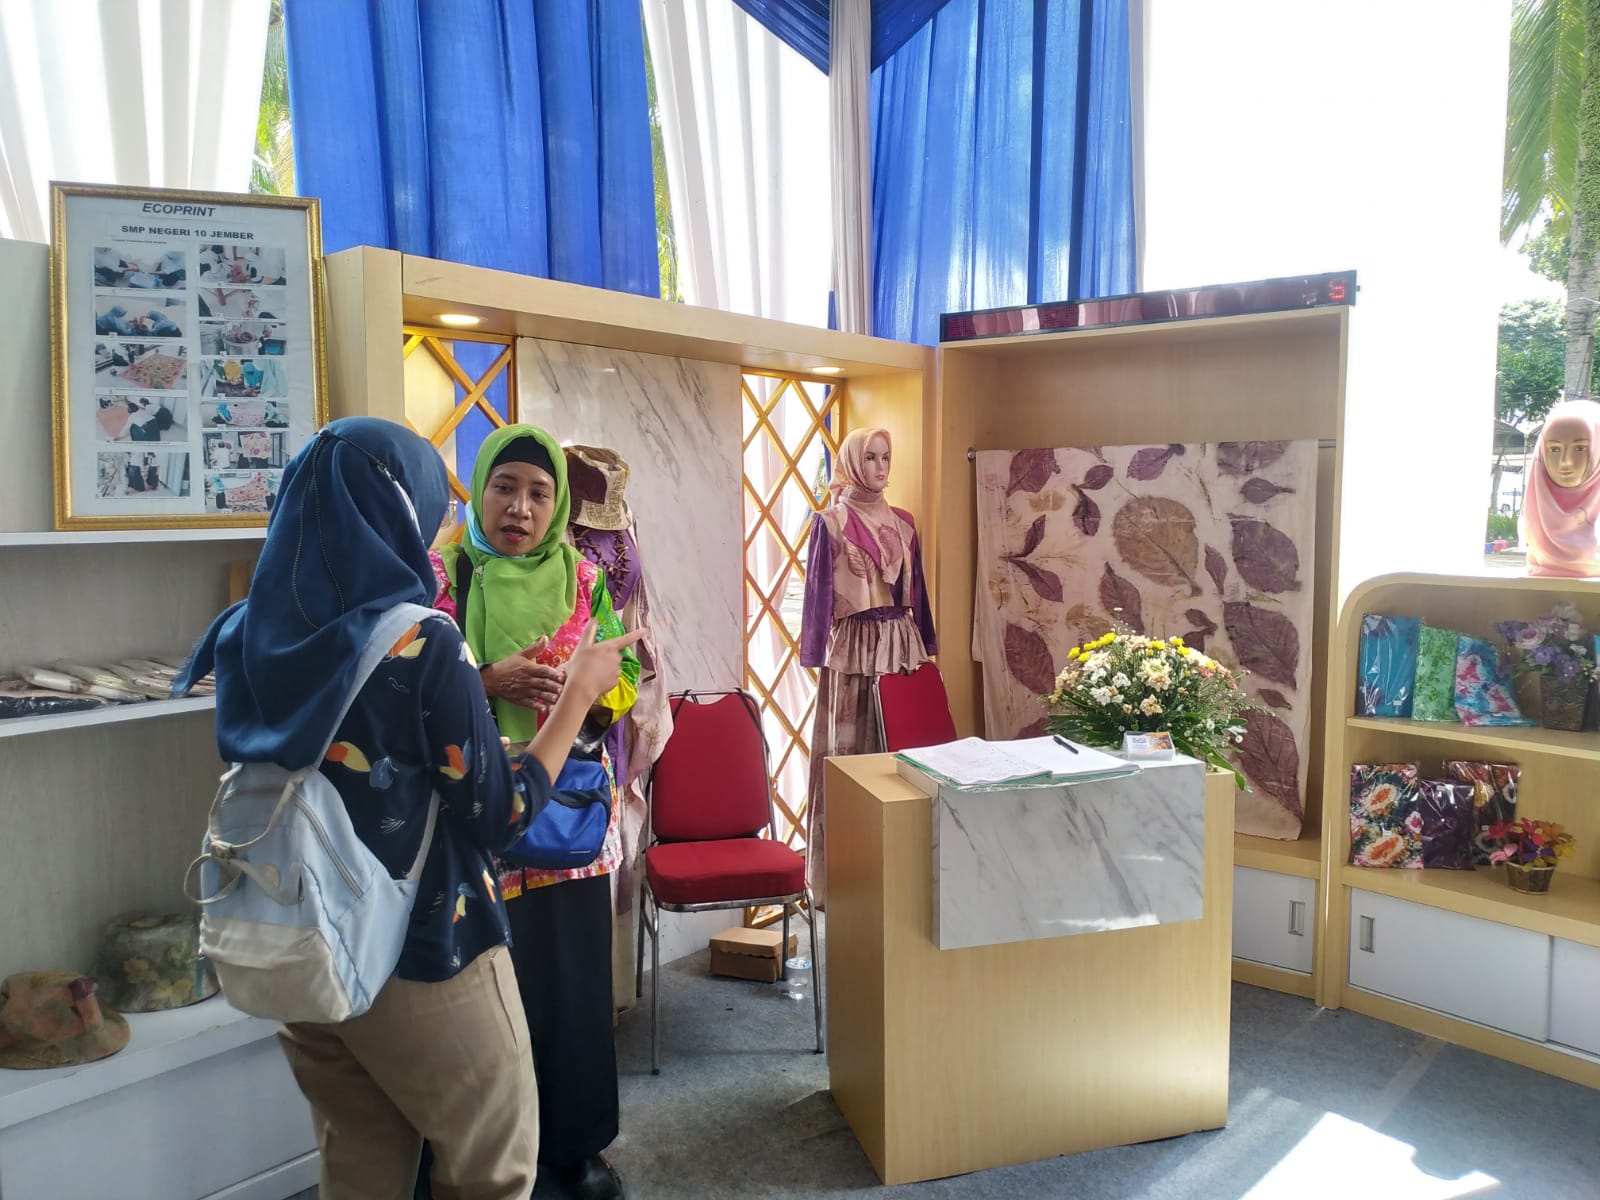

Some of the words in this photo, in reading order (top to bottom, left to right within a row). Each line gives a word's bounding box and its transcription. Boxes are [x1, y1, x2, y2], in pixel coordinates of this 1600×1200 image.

[142, 202, 216, 217] ECOPRINT
[121, 225, 146, 233] SMP
[149, 227, 191, 237] NEGERI
[194, 229, 207, 238] 10
[210, 231, 255, 240] JEMBER
